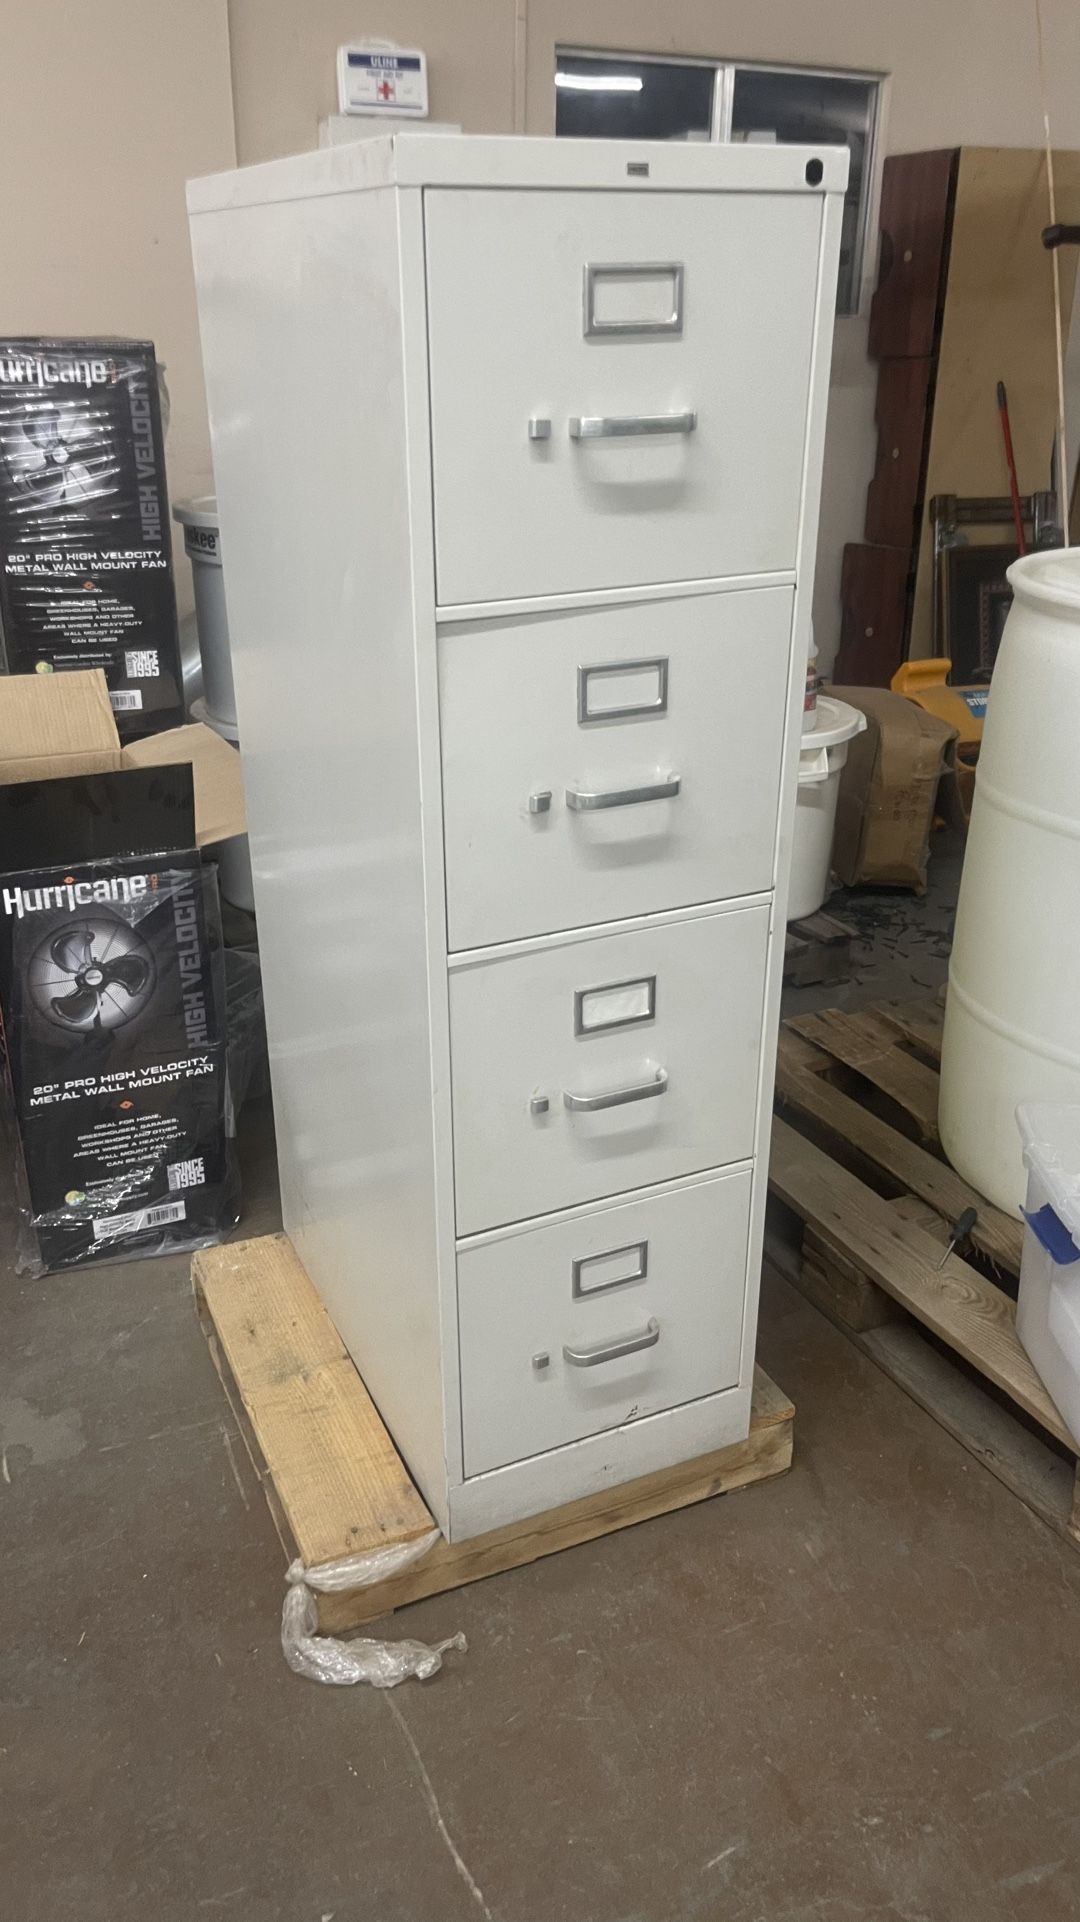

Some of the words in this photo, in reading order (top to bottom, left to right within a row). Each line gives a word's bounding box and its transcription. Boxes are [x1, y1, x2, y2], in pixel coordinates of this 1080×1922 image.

[138, 485, 162, 541] HIGH
[7, 554, 31, 563] 20"
[35, 553, 63, 562] PRO
[66, 552, 97, 561] HIGH
[100, 550, 162, 560] VELOCITY
[4, 563, 50, 574] METAL
[52, 562, 88, 571] WALL
[90, 561, 138, 570] MOUNT
[141, 560, 167, 569] FAN
[131, 650, 158, 663] SINCE
[133, 662, 160, 677] 1995
[2, 874, 148, 919] Hurricane
[168, 868, 202, 989] VELOCITY
[182, 991, 208, 1049] HIGH
[29, 1091, 80, 1106] METAL
[84, 1083, 125, 1096] WALL
[128, 1072, 181, 1089] MOUNT
[185, 1063, 214, 1078] FAN
[33, 1083, 59, 1096] 20"
[64, 1077, 96, 1090] PRO
[100, 1070, 136, 1083] HIGH
[140, 1055, 208, 1076] VELOCITY
[77, 1126, 138, 1141] GREENHOUSES,
[140, 1118, 180, 1129] GARAGES,
[94, 1122, 117, 1130] IDEAL
[118, 1118, 135, 1126] FOR
[136, 1113, 161, 1122] HOME,
[81, 1134, 131, 1148] WORKSHOPS
[133, 1130, 152, 1139] AND
[152, 1125, 178, 1135] OTHER
[73, 1148, 100, 1158] AREAS
[102, 1143, 129, 1152] WHERE
[97, 1153, 118, 1161] WALL
[119, 1147, 148, 1157] MOUNT
[149, 1143, 167, 1151] FAN
[106, 1159, 124, 1167] CAN
[174, 1157, 204, 1174] SINCE
[175, 1168, 206, 1189] 1995
